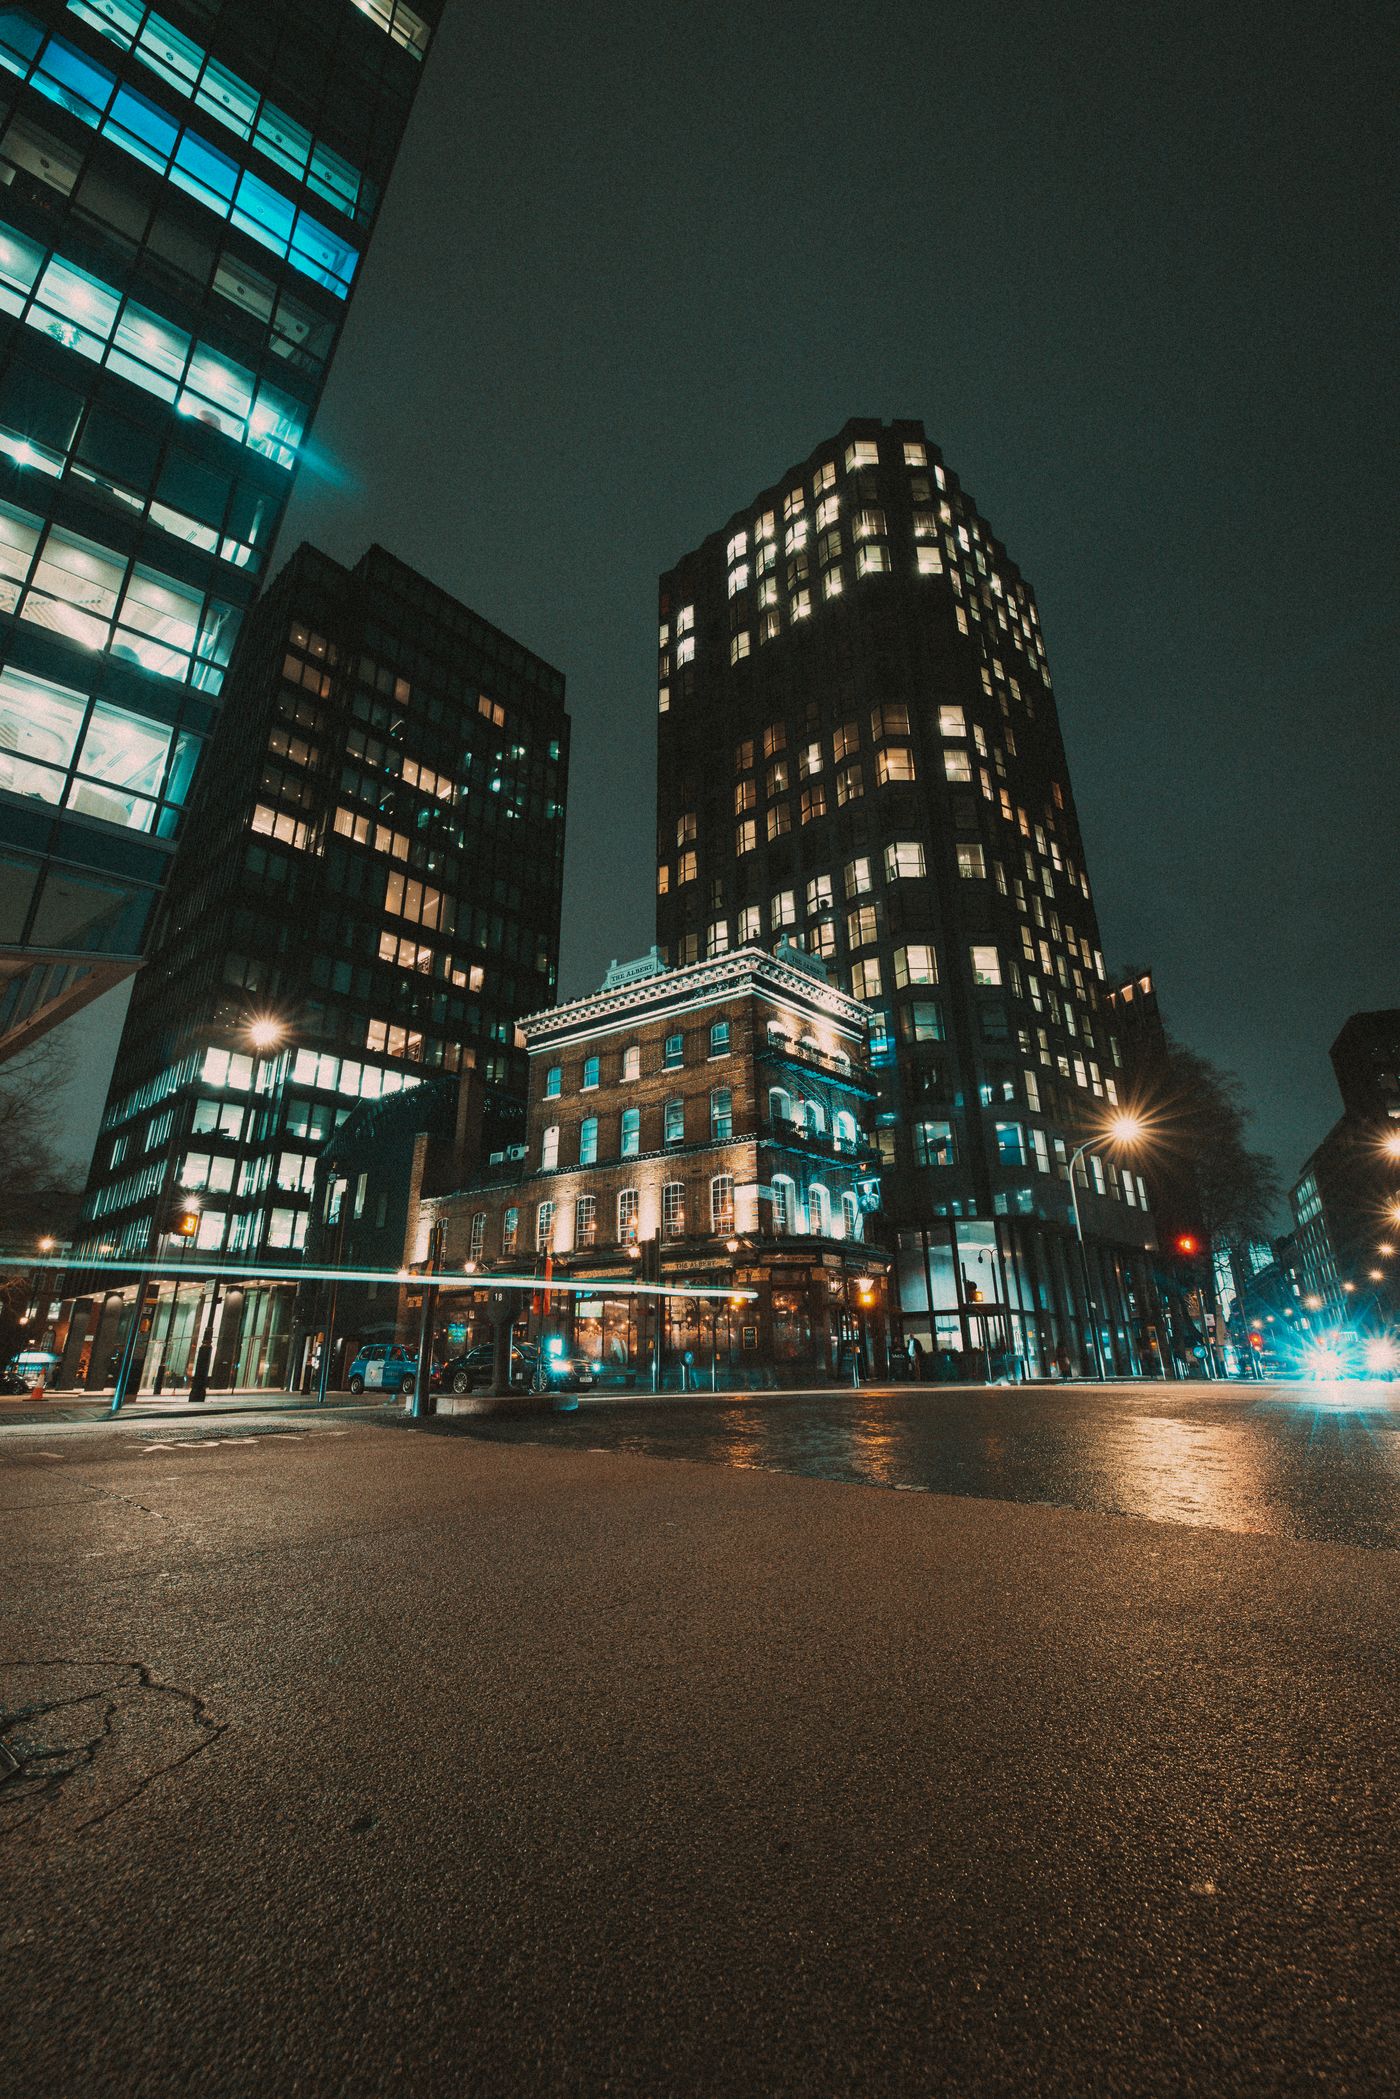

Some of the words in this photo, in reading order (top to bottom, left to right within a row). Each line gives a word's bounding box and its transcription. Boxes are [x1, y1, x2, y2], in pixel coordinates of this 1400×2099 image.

[611, 973, 625, 982] THE
[626, 964, 653, 977] ALBERT
[494, 1292, 503, 1302] 18
